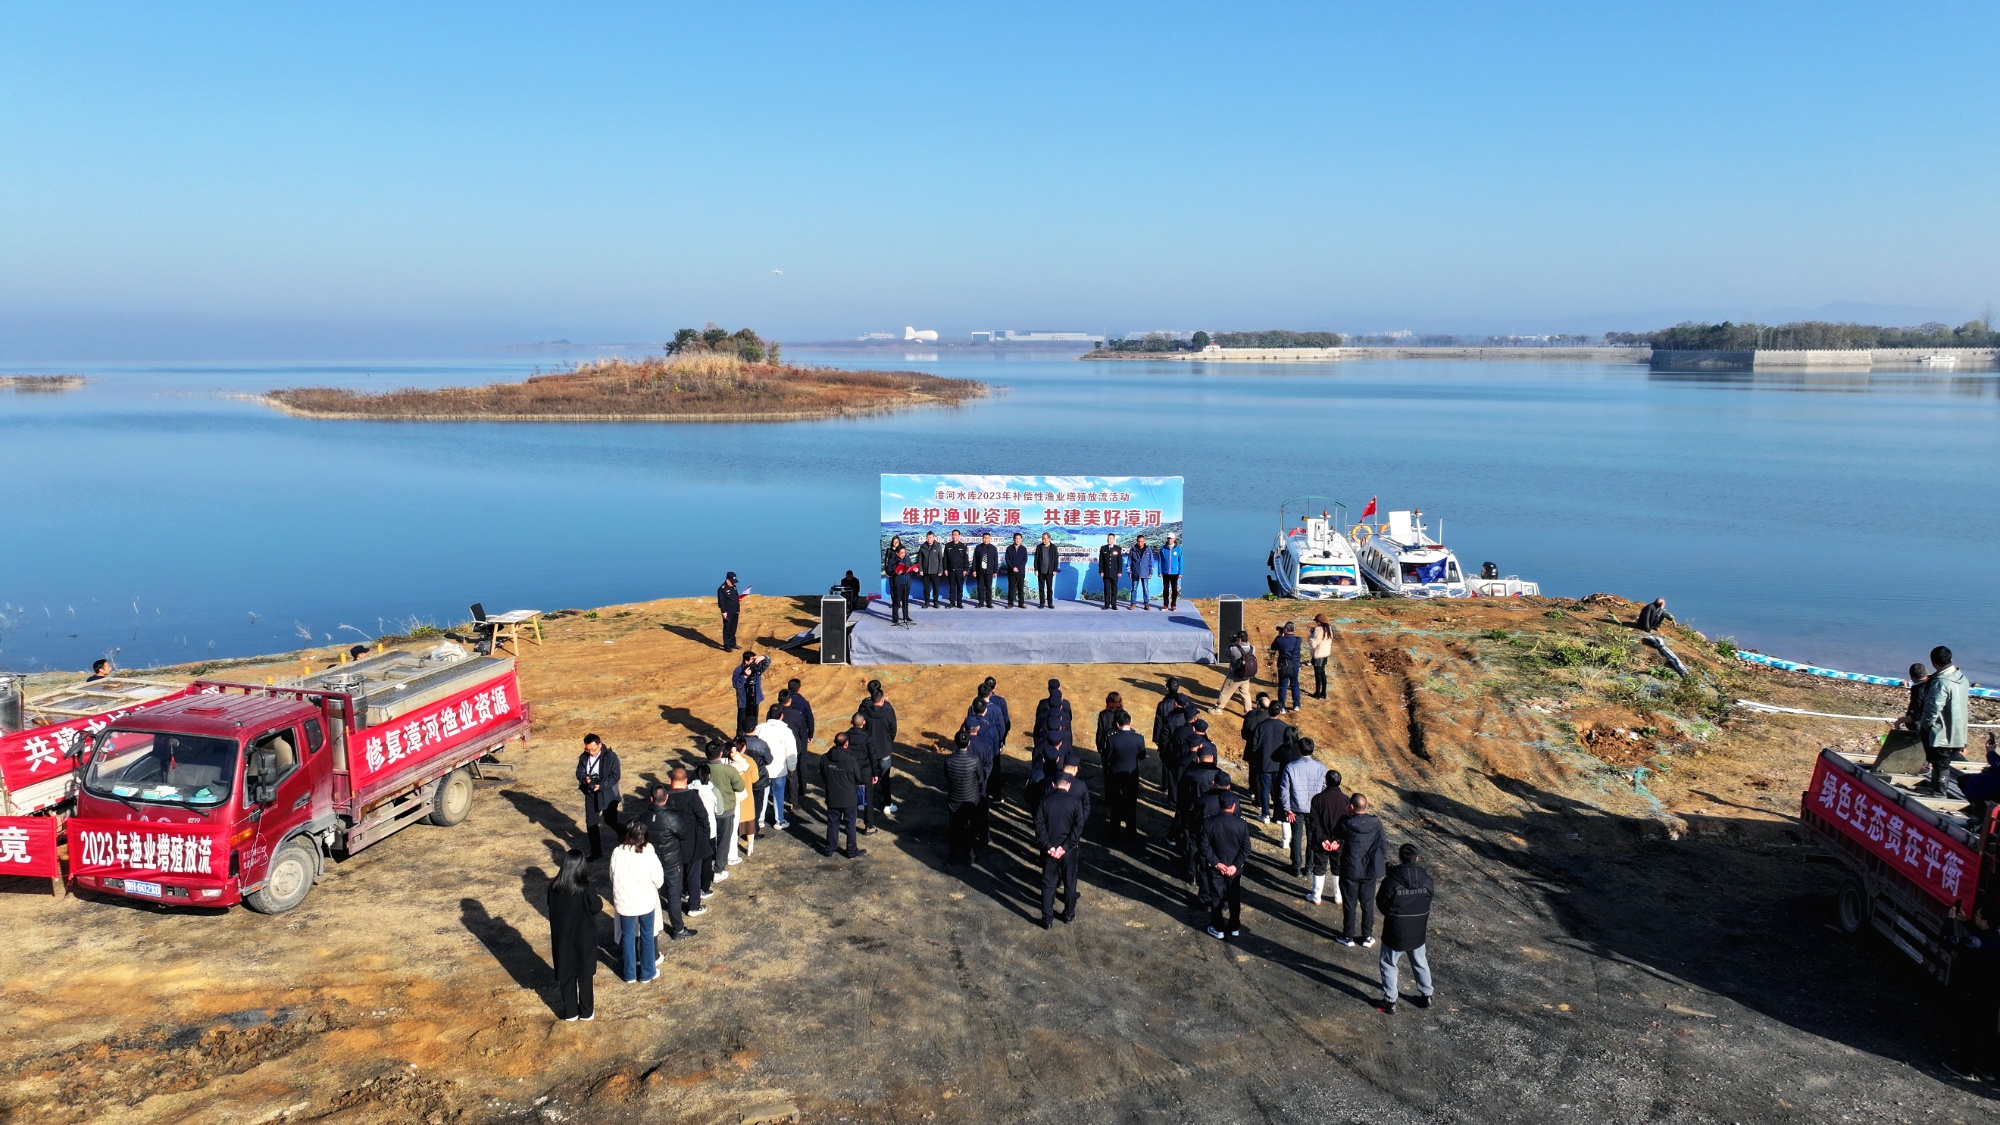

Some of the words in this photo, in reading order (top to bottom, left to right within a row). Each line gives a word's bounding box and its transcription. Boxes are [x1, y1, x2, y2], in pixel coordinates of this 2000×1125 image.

[903, 508, 1021, 526] 维护渔业资源
[1044, 509, 1162, 527] 共建美好漳河
[365, 685, 511, 773] 修复漳河渔业资源
[81, 831, 212, 873] 2023年渔业增殖放流
[1819, 771, 1964, 896] 绿色生态贵在平衡
[1397, 887, 1428, 896] BIRDING
